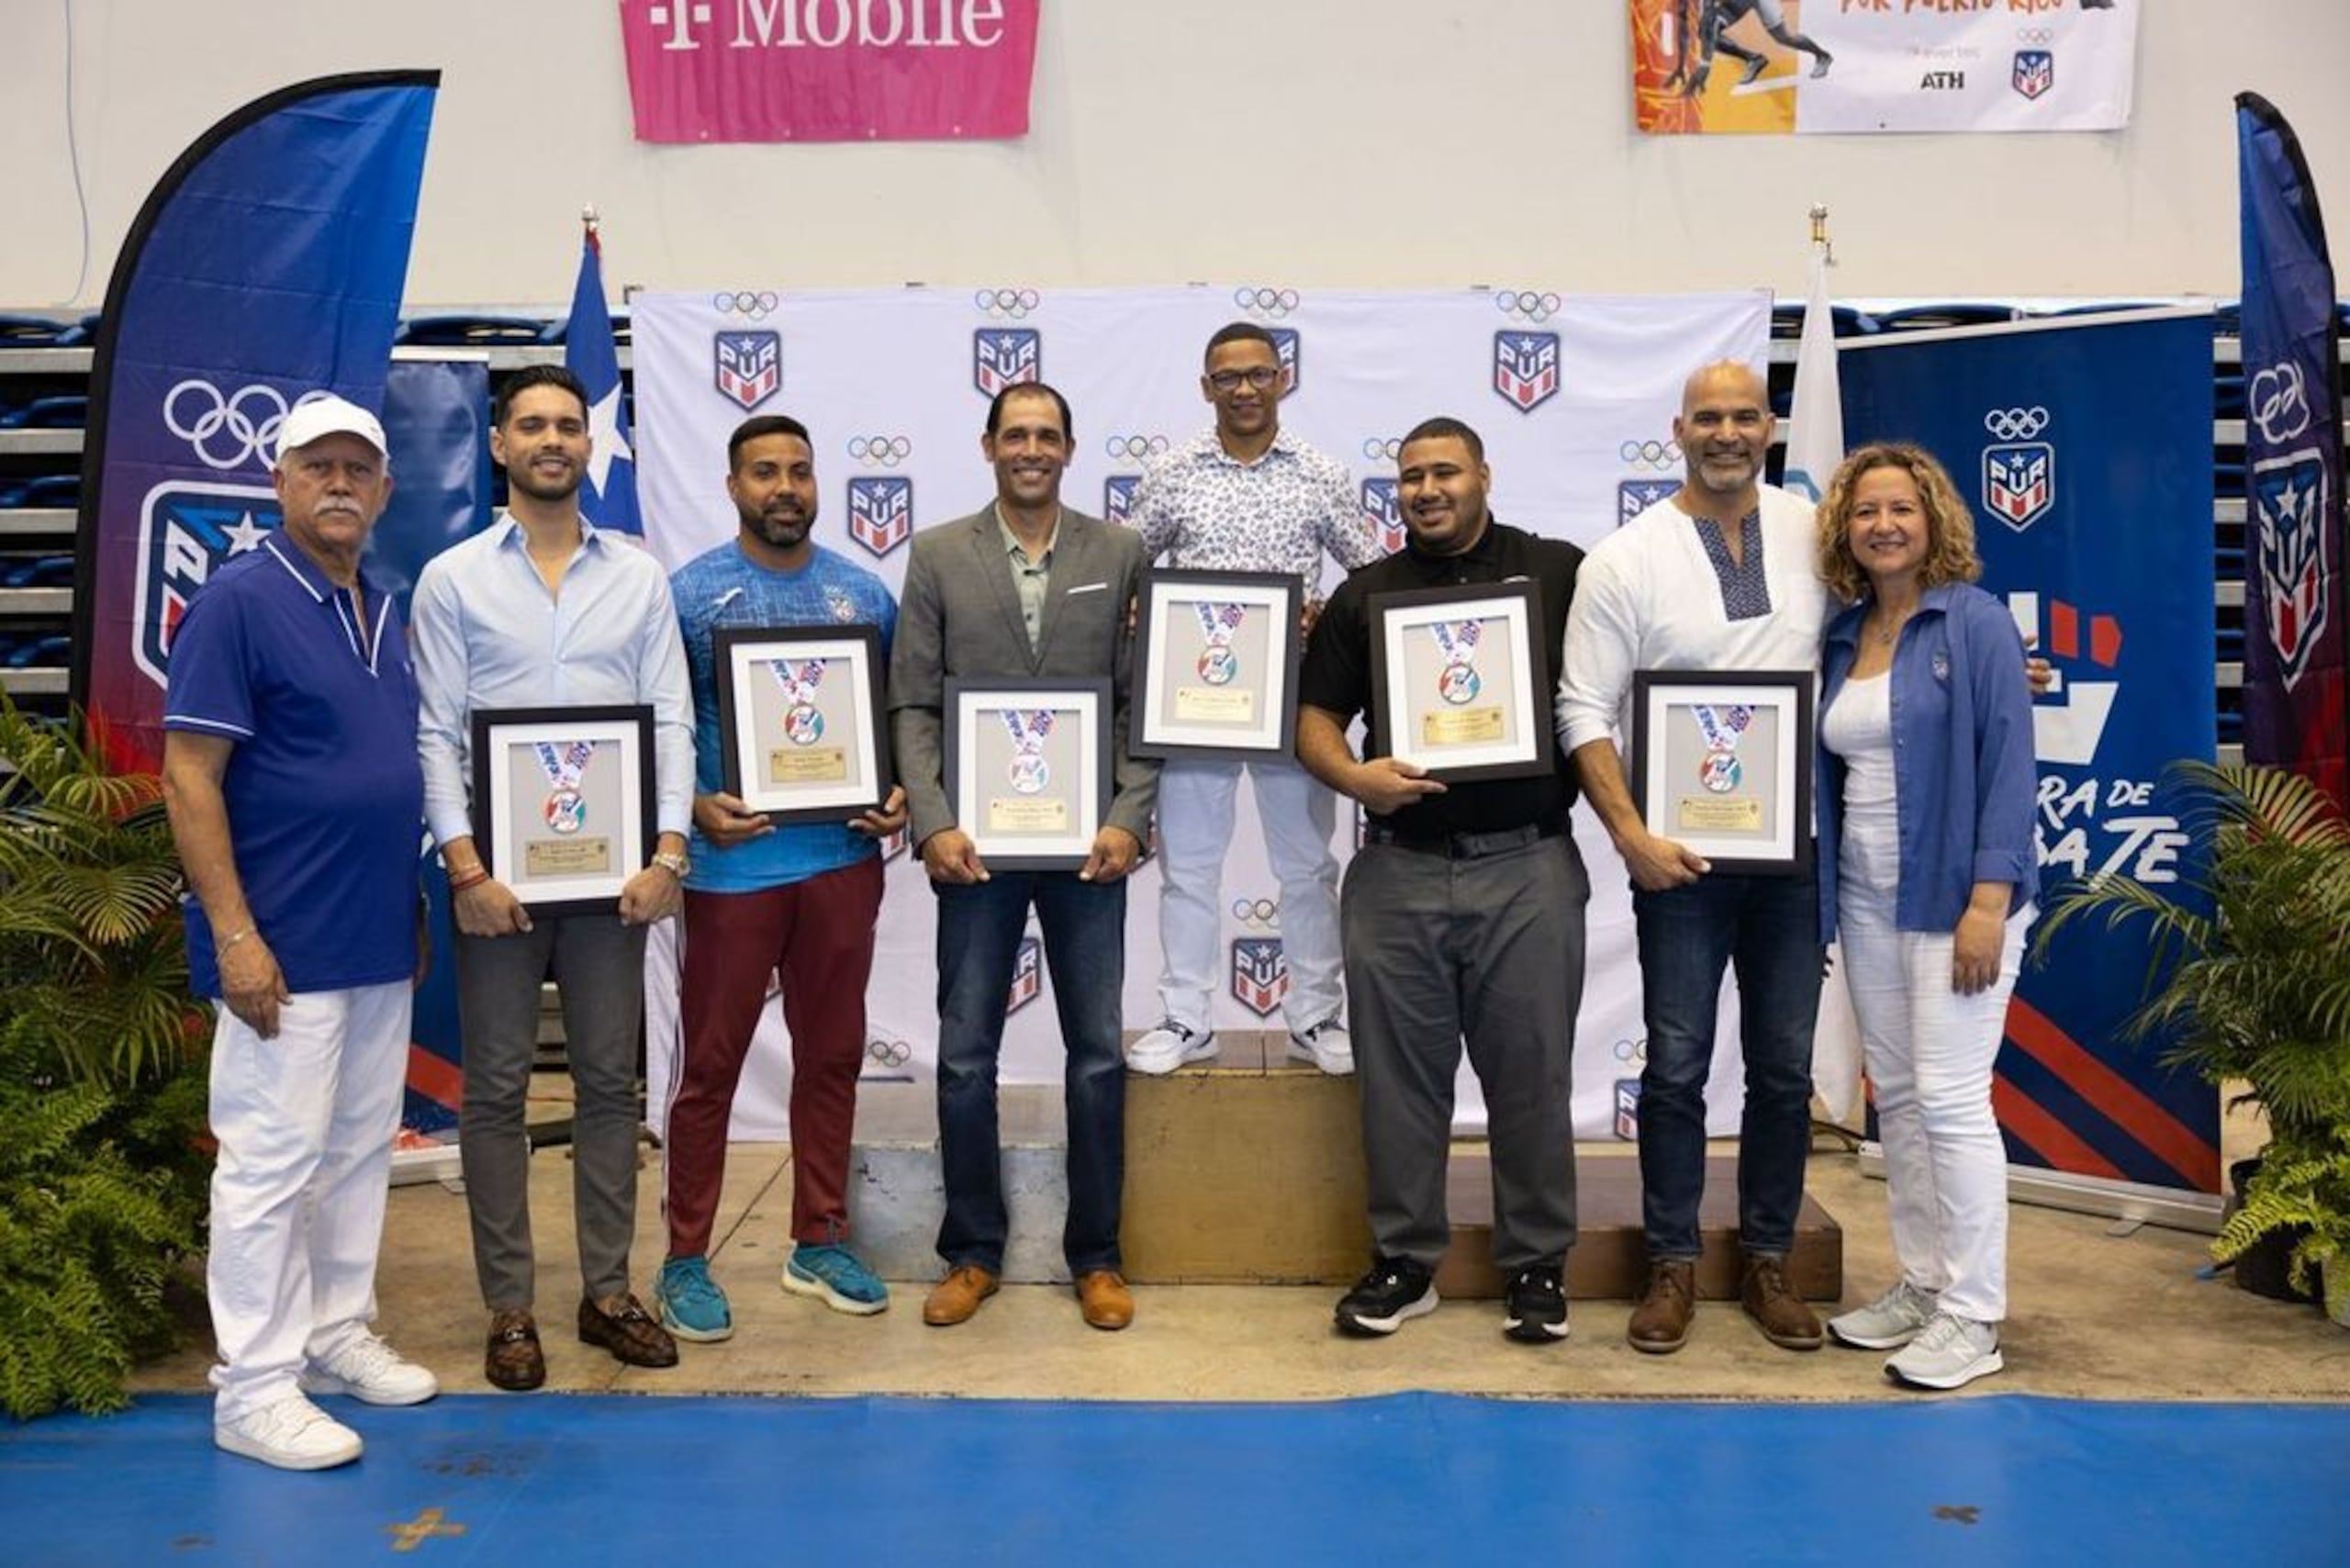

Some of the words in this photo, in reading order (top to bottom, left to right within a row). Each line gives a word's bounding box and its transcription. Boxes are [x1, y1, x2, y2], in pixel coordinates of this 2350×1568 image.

[1920, 72, 1964, 89] ATH
[2037, 776, 2098, 830] RA
[2106, 779, 2154, 808] DE
